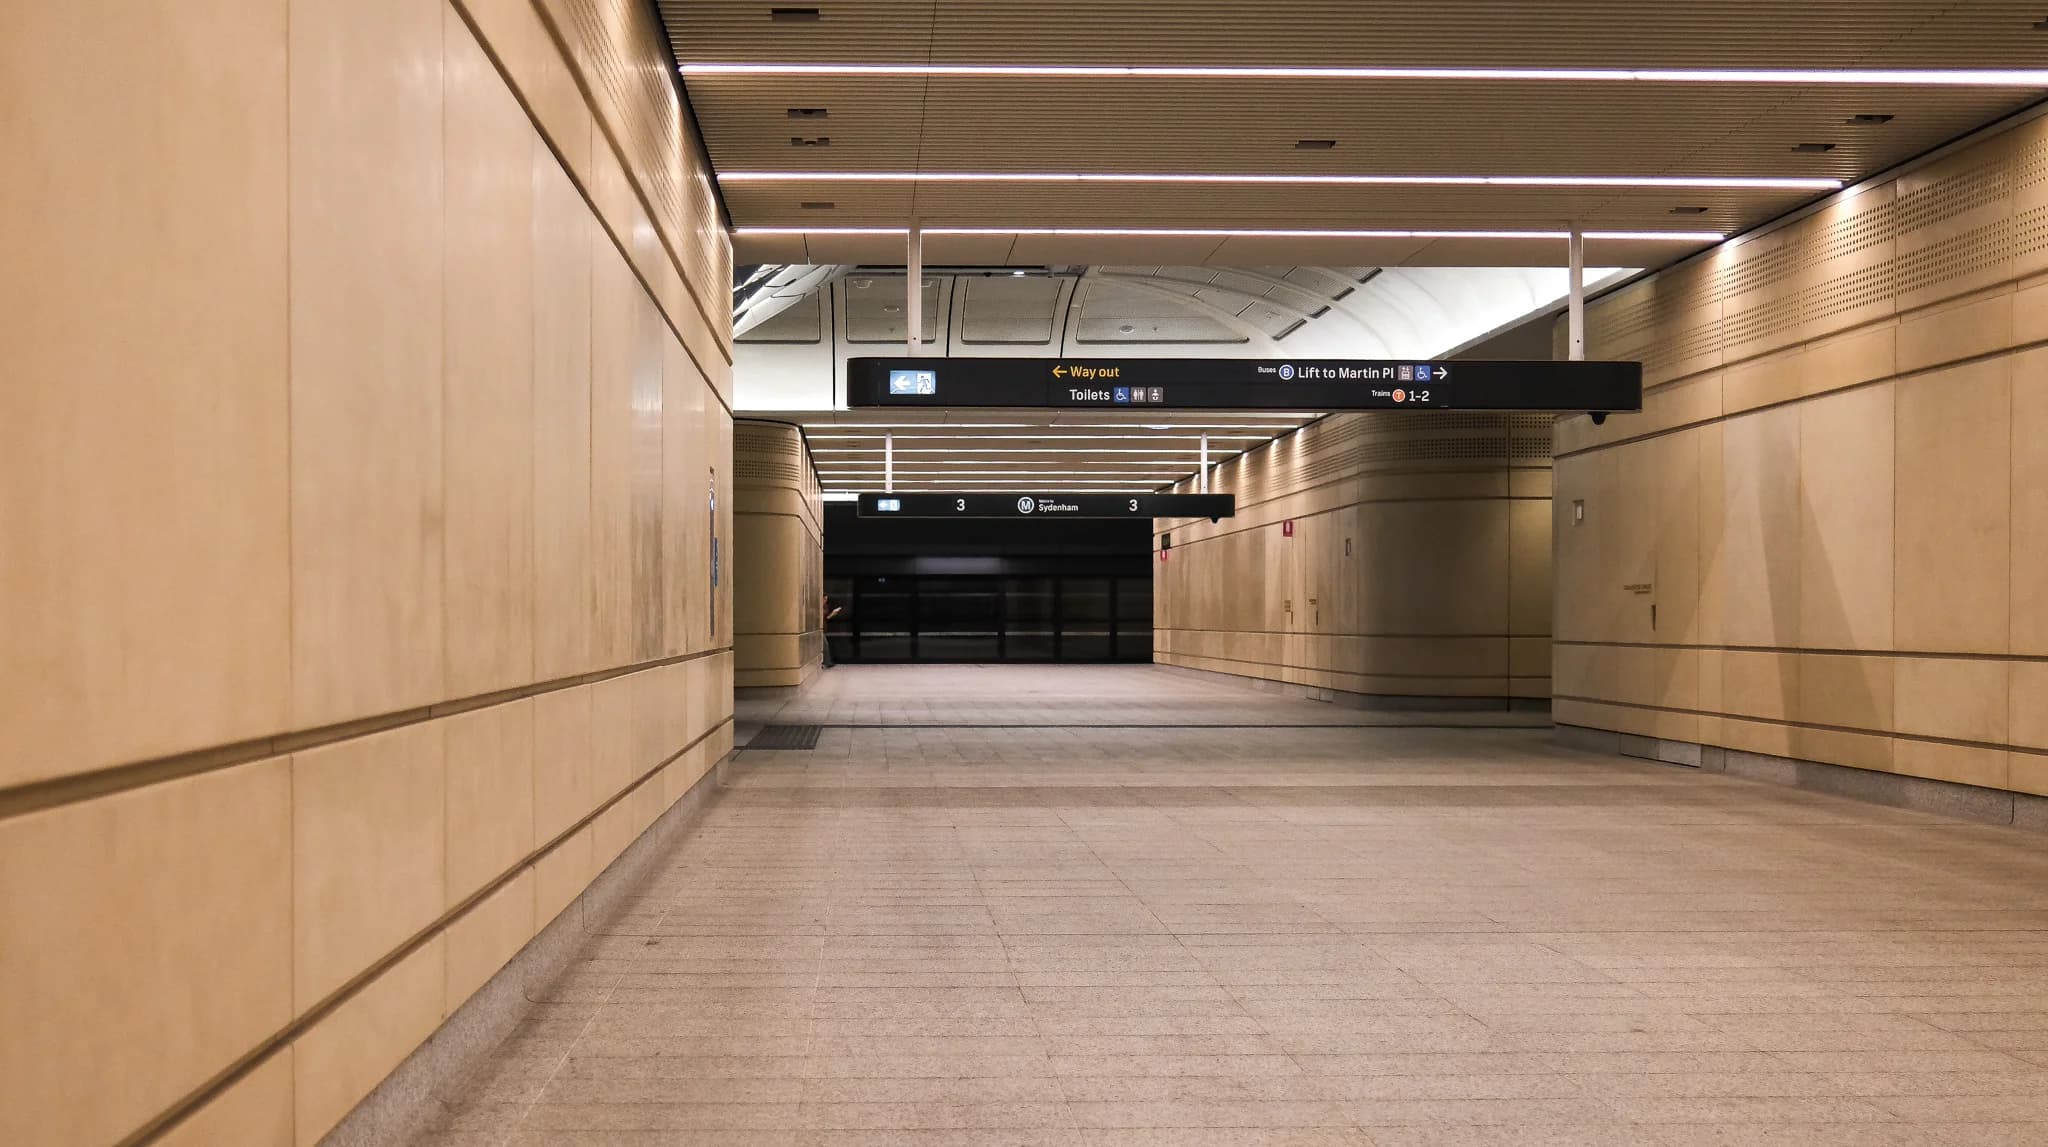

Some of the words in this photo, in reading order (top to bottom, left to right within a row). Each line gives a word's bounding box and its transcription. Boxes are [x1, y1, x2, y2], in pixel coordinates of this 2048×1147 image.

[1070, 366, 1096, 379] Way
[1099, 367, 1120, 378] out
[1298, 367, 1319, 379] Lift
[1323, 367, 1335, 379] to
[1339, 367, 1379, 379] Martin
[1069, 389, 1110, 401] Toilets
[1408, 390, 1430, 402] 1-2
[957, 499, 966, 511] 3
[1038, 503, 1079, 512] Sydenham
[1129, 499, 1138, 511] 3
